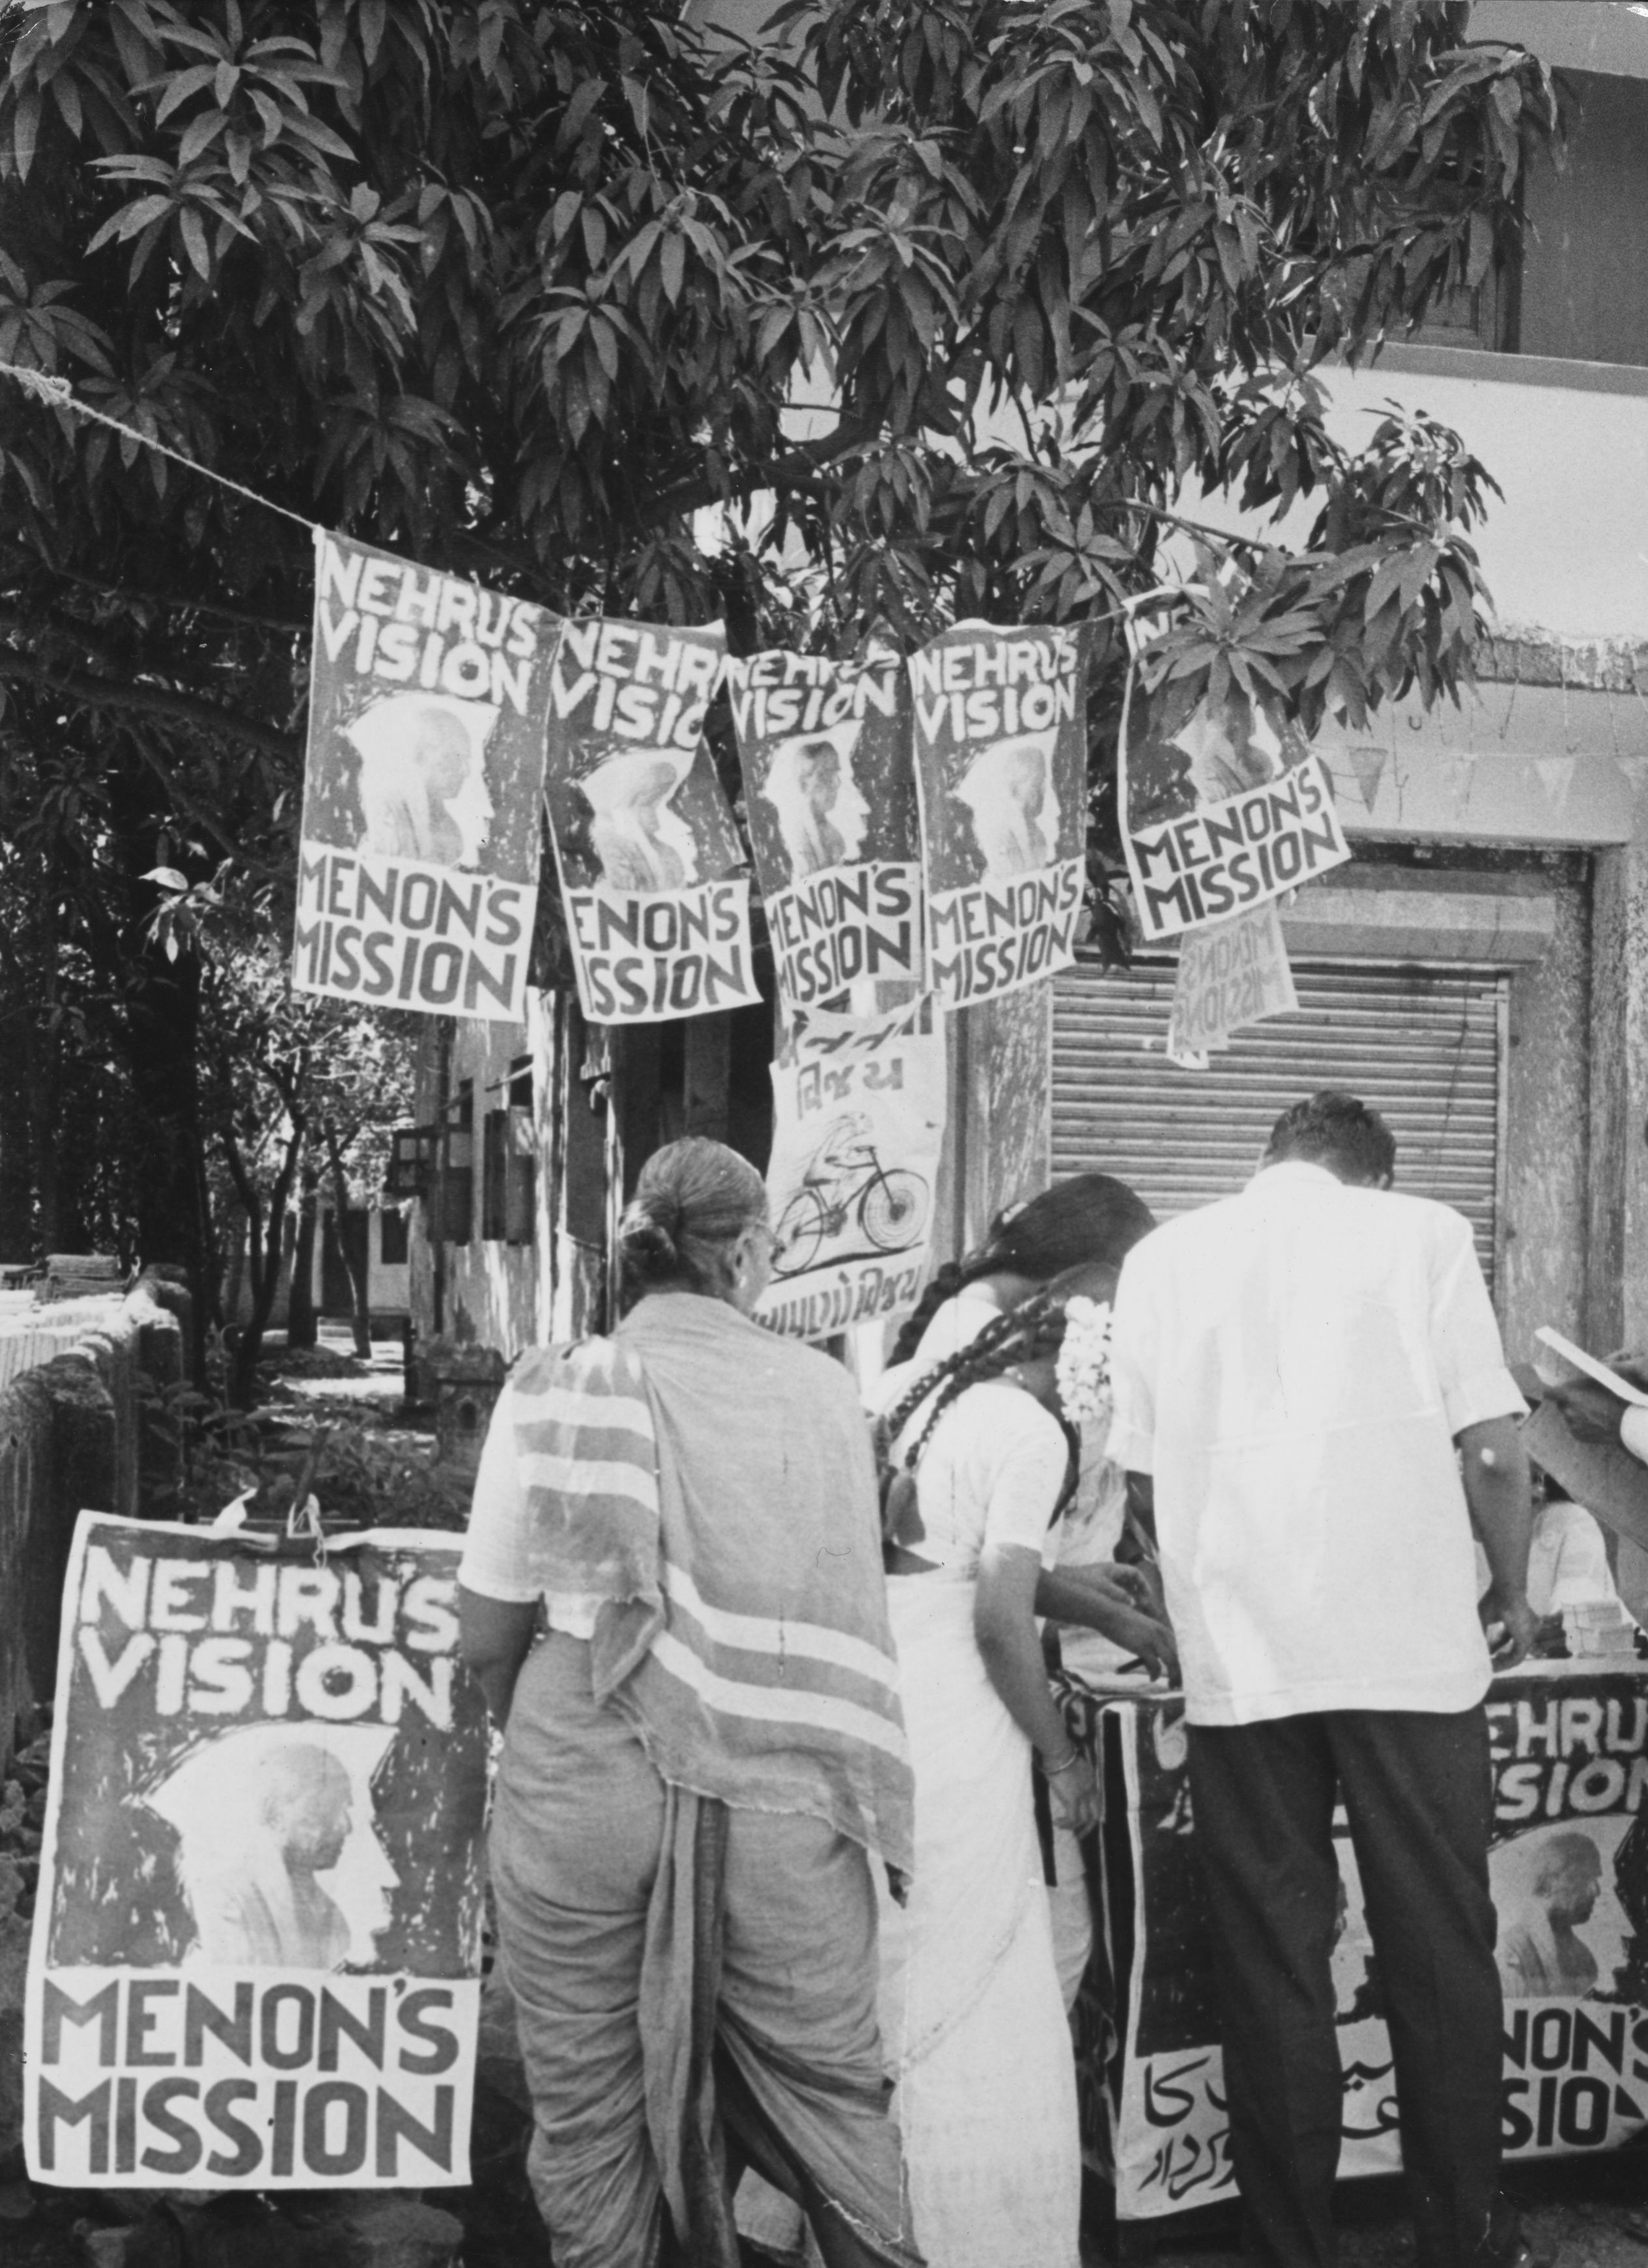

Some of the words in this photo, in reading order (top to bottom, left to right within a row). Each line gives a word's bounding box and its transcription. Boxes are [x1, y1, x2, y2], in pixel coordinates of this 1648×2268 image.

[319, 598, 533, 715] VISION
[730, 671, 898, 743] VISION
[916, 673, 1077, 744] VISION
[1131, 767, 1322, 879] MENON'S
[1143, 811, 1339, 930] MISSION
[299, 851, 522, 946] MENON'S
[930, 861, 1078, 950] MENON'S
[294, 919, 518, 1013] MISSION
[932, 912, 1073, 1002] MISSION
[78, 1626, 455, 1732] VISION
[41, 1977, 459, 2077] MENON'S
[38, 2075, 455, 2178] MISSION
